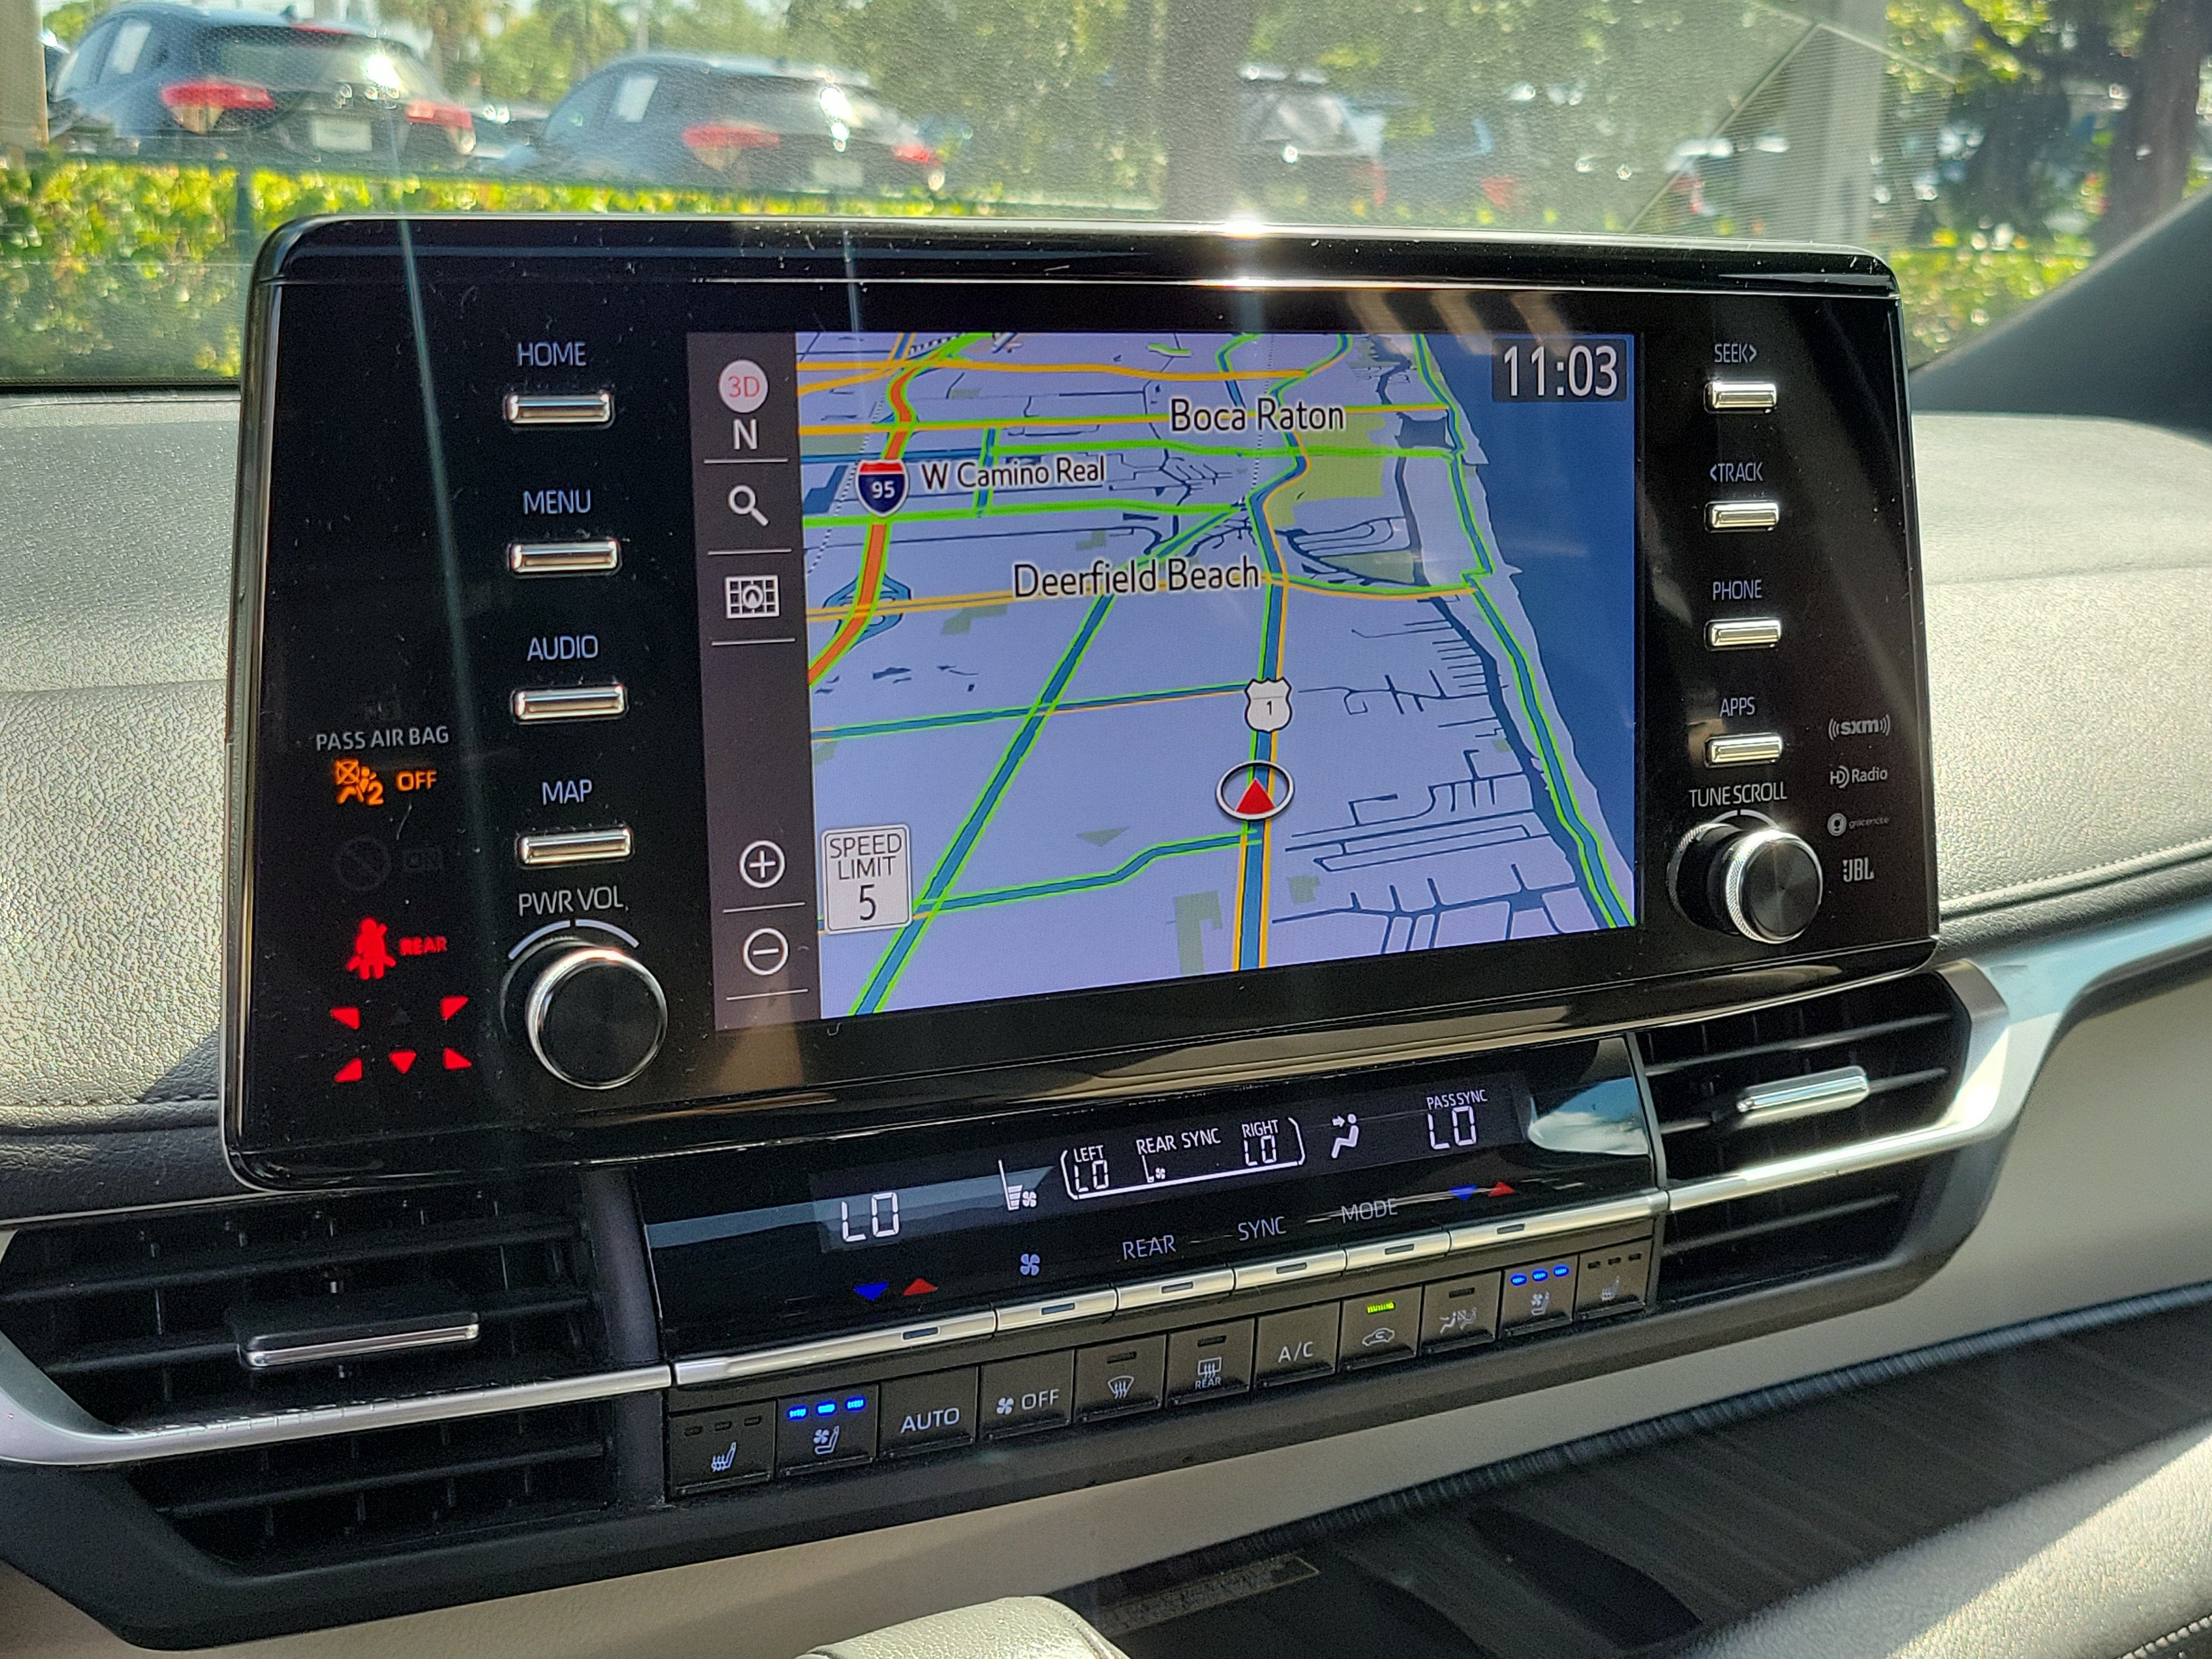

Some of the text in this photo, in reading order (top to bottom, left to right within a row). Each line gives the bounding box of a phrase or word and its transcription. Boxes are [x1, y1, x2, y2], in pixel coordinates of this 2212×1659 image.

[517, 342, 587, 366] HOME
[1503, 345, 1618, 397] 11:03
[727, 376, 760, 398] 3D
[1170, 398, 1345, 432] Boca Raton
[733, 419, 758, 450] N
[921, 456, 1105, 489] W Camino Real
[523, 489, 591, 515] MENU
[871, 481, 895, 499] 95
[1013, 555, 1259, 598] Deerfield Beach
[1712, 579, 1762, 600] PHONE
[527, 635, 599, 661] AUDIO
[1266, 700, 1273, 715] 1
[1719, 696, 1756, 717] APPS
[316, 725, 449, 752] PASS AIR BAG
[396, 769, 437, 792] OFF
[1852, 766, 1888, 783] Radio
[541, 779, 592, 805] MAP
[1689, 781, 1787, 808] TUNE SCROLL
[829, 832, 902, 860] SPEED
[838, 856, 896, 881] LIMIT
[1843, 857, 1875, 883] JBL
[518, 885, 624, 917] PWR VOL
[859, 884, 876, 921] 5
[399, 936, 447, 956] REAR
[1426, 1089, 1488, 1111] PASS SYNC
[1136, 1128, 1222, 1155] REAR SYNC
[1242, 1119, 1279, 1138] RIGHT
[1074, 1144, 1105, 1163] LEFT
[1341, 1198, 1398, 1224] MODE
[1238, 1217, 1288, 1242] SYNC
[1122, 1234, 1177, 1261] REAR
[1278, 1341, 1314, 1363] A/C
[1194, 1376, 1223, 1390] REAR
[1021, 1389, 1060, 1412] OFF
[900, 1407, 961, 1434] AUTO
